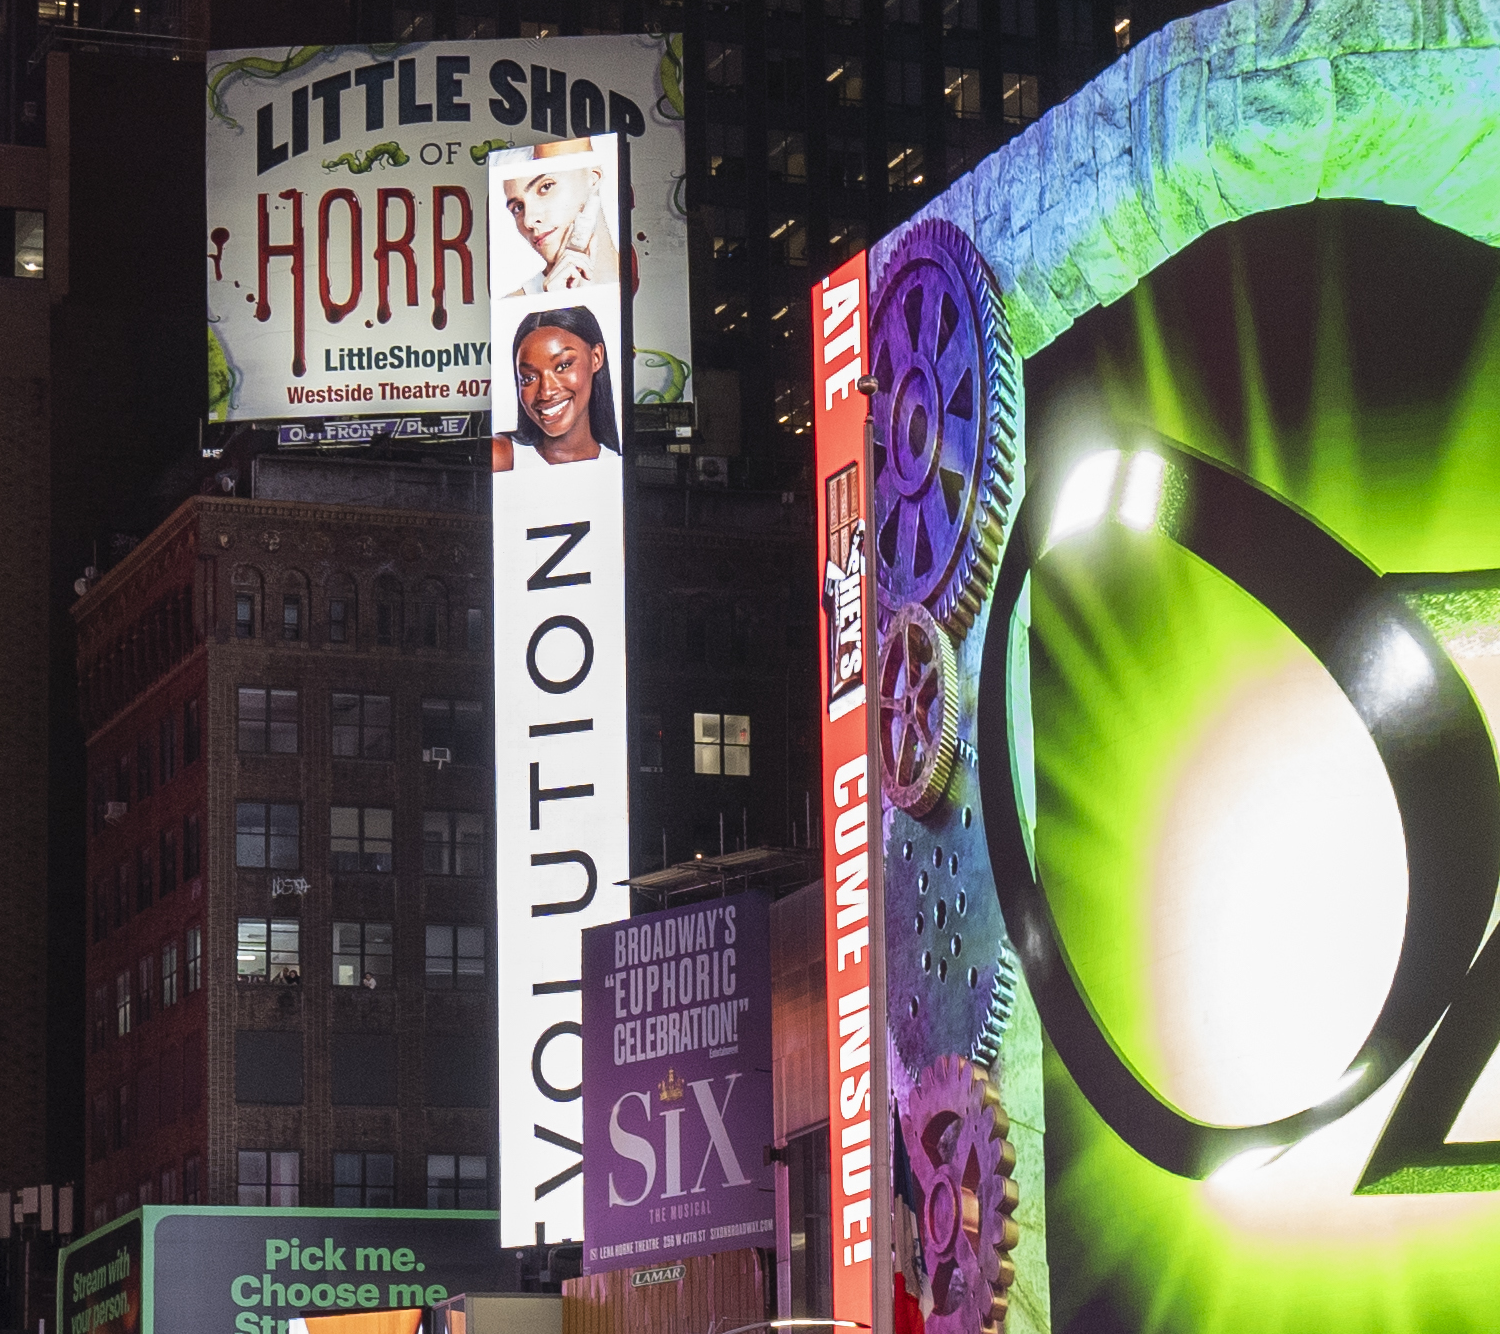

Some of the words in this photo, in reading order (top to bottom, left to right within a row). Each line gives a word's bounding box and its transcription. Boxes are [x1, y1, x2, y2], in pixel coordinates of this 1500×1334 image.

[256, 55, 471, 176] LITTLE
[488, 59, 646, 142] SHOP
[419, 141, 462, 166] OF
[256, 184, 491, 378] HORR
[821, 275, 867, 412] ATE
[286, 384, 375, 406] Westside
[378, 380, 451, 402] Theatre
[456, 377, 492, 399] 407
[838, 555, 866, 681] HEY'S
[833, 753, 870, 973] COME
[614, 905, 737, 969] BROADWAY'S
[837, 984, 873, 1267] INSIDE!
[648, 1208, 667, 1225] THE
[670, 1199, 712, 1221] MUSICAL
[265, 1238, 346, 1273] Pick
[353, 1244, 426, 1274] me.
[635, 1236, 660, 1253] THEATRE
[72, 1264, 108, 1303] Stream
[108, 1245, 131, 1286] with
[230, 1273, 381, 1309] Choose
[634, 1265, 682, 1285] LAMAR
